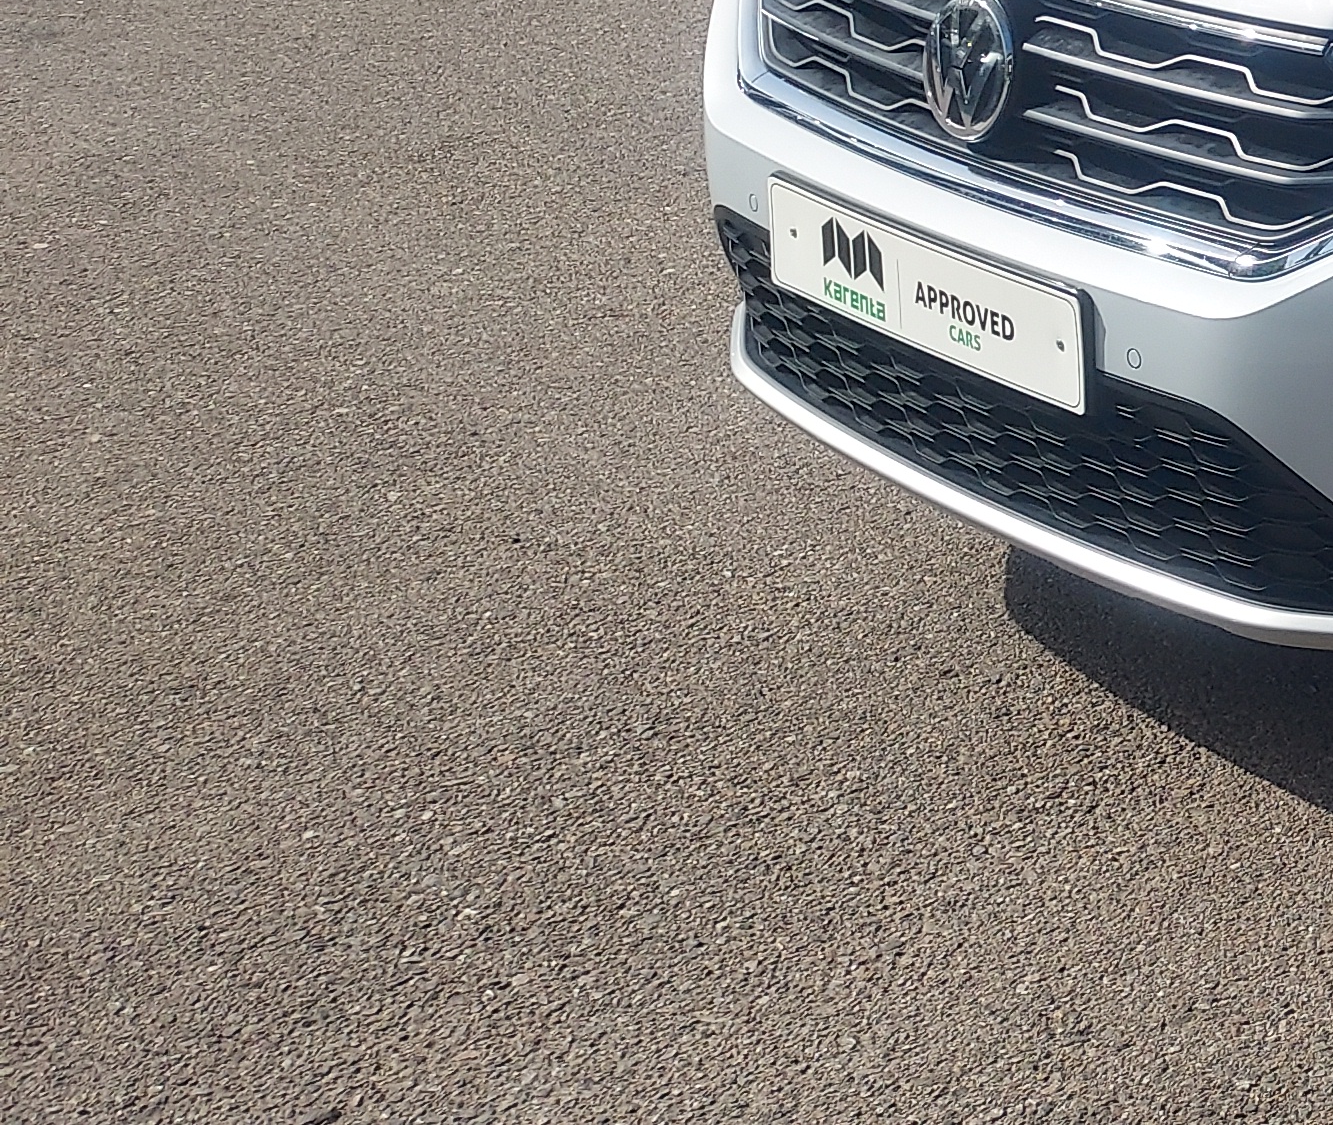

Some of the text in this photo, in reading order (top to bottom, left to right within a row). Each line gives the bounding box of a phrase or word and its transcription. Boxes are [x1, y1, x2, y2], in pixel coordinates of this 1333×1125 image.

[823, 277, 886, 322] karenta
[914, 281, 1014, 341] APPROVED
[949, 325, 981, 351] CARS
